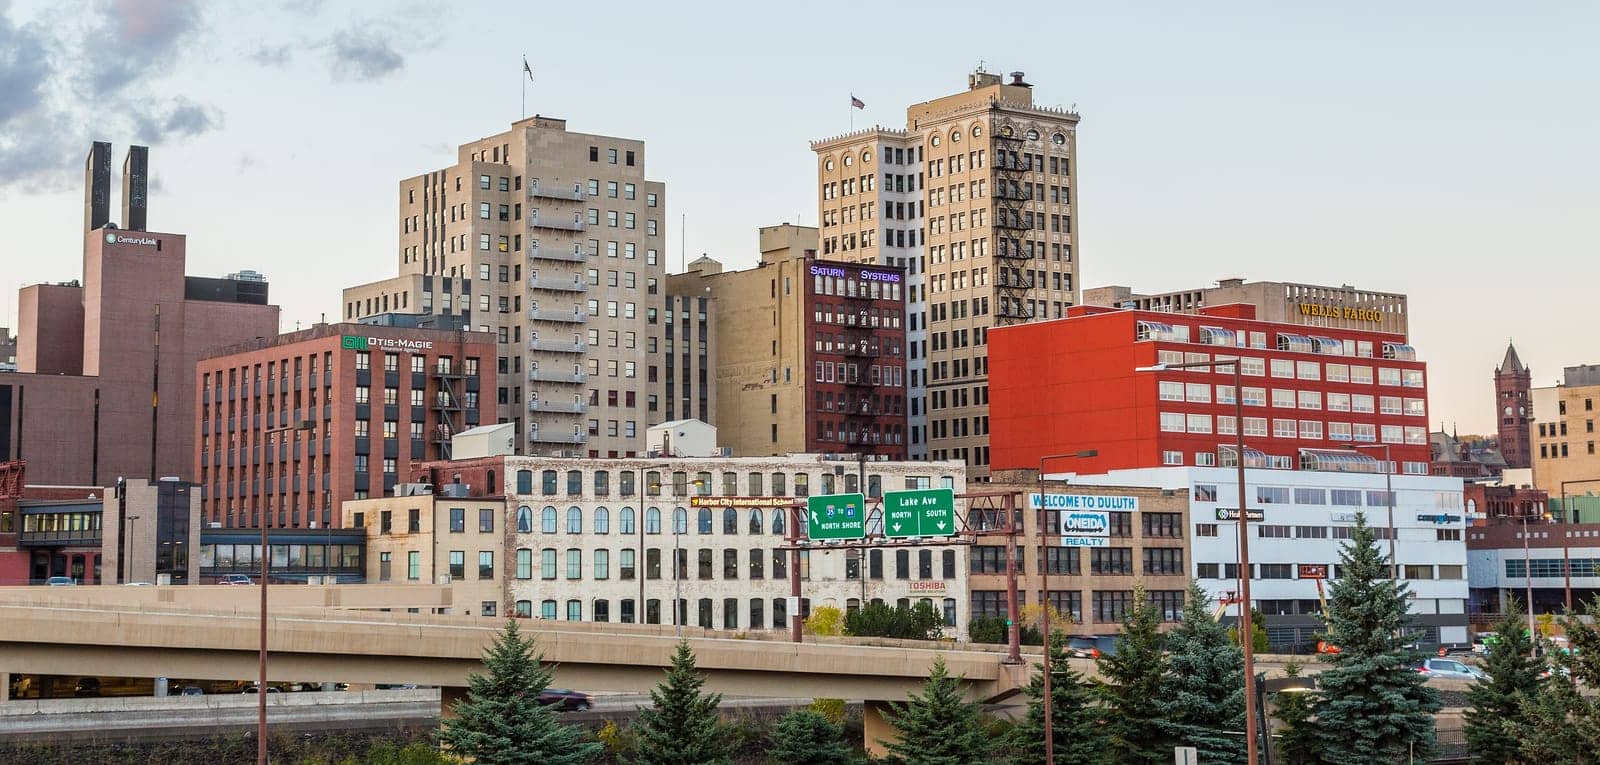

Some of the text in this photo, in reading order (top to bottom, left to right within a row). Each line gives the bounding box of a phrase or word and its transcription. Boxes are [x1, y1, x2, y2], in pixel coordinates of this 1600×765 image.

[117, 236, 156, 245] CenturyLink
[810, 266, 900, 282] SATURN SYSTEMS
[1299, 303, 1382, 322] WELLS FARGO
[368, 337, 432, 349] OTIS-MAGIE
[720, 498, 732, 507] City
[900, 496, 936, 506] Lake Ave
[1032, 494, 1135, 509] WELCOME TO DULUTH
[822, 522, 840, 530] NORTH
[1065, 514, 1106, 531] ONEIDA
[1066, 538, 1104, 546] REALTY
